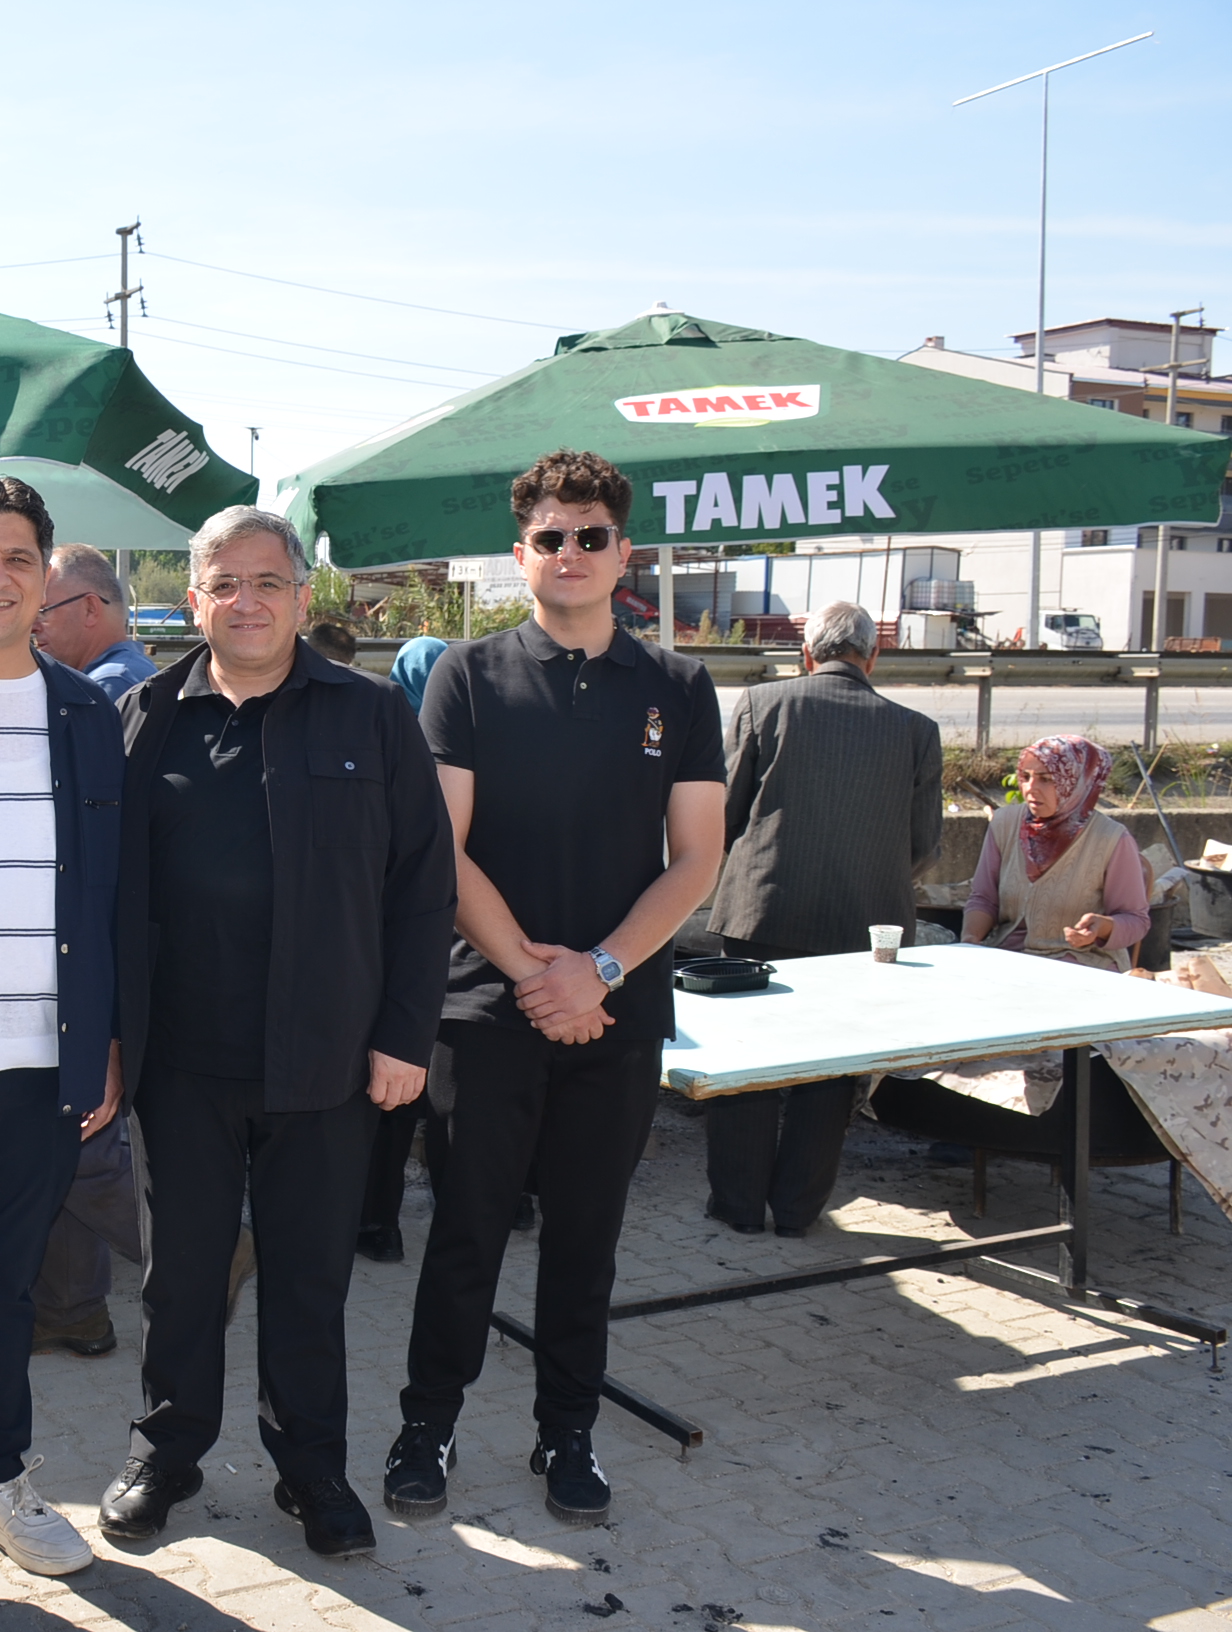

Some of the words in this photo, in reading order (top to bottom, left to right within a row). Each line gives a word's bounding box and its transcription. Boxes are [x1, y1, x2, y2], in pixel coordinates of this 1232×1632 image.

[622, 391, 815, 418] TAMEK
[124, 428, 209, 494] TAMEK
[966, 452, 1071, 485] Sepete
[653, 464, 895, 535] TAMEK
[644, 747, 662, 758] POLO
